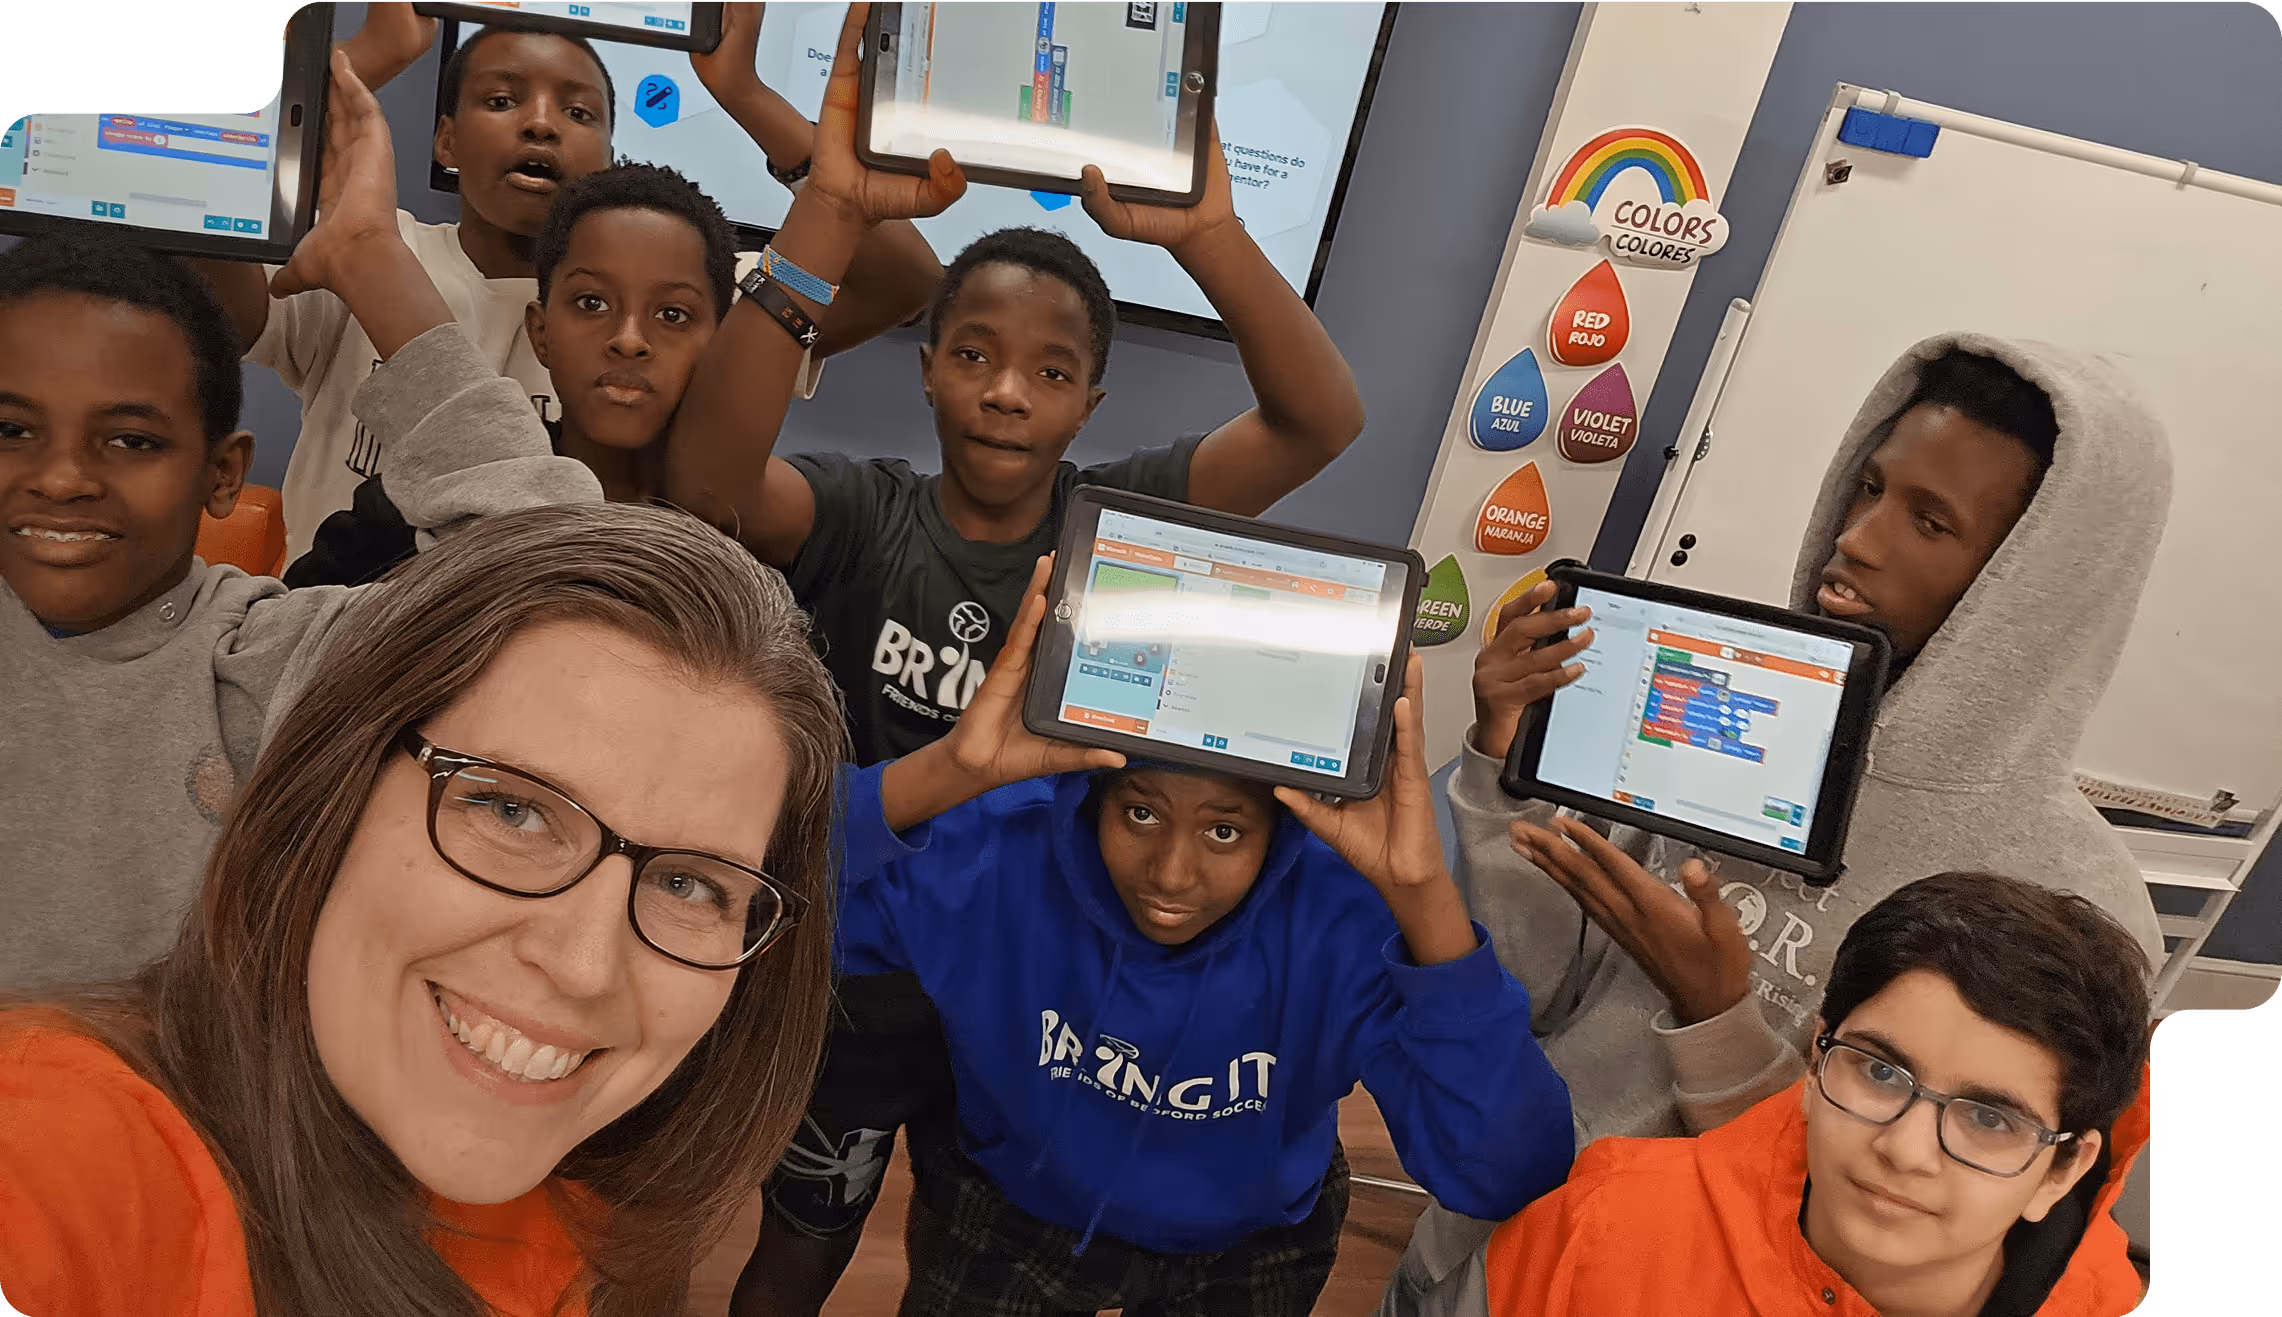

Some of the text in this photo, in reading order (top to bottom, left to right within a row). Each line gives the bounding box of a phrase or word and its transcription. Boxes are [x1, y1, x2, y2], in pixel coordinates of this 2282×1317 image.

[807, 47, 833, 63] Doe
[1233, 144, 1289, 165] questions
[1290, 157, 1306, 169] do
[1233, 158, 1262, 173] have
[1262, 165, 1281, 178] for
[1280, 171, 1289, 180] a
[1613, 200, 1718, 245] COLORS
[1615, 234, 1696, 265] COLORES
[1572, 310, 1611, 330] RED
[1568, 331, 1606, 348] ROJO
[1490, 396, 1534, 417] BLUE
[1490, 417, 1521, 433] AZUL
[1572, 408, 1633, 435] VIOLET
[1570, 428, 1620, 449] VIOLETA
[1485, 505, 1548, 530] ORANGE
[1483, 525, 1535, 545] NARANJA
[881, 683, 941, 720] FRIENDS
[942, 713, 961, 722] O
[1050, 1065, 1102, 1091] RIEDS
[1105, 1089, 1127, 1101] OF
[1228, 1051, 1278, 1102] IT
